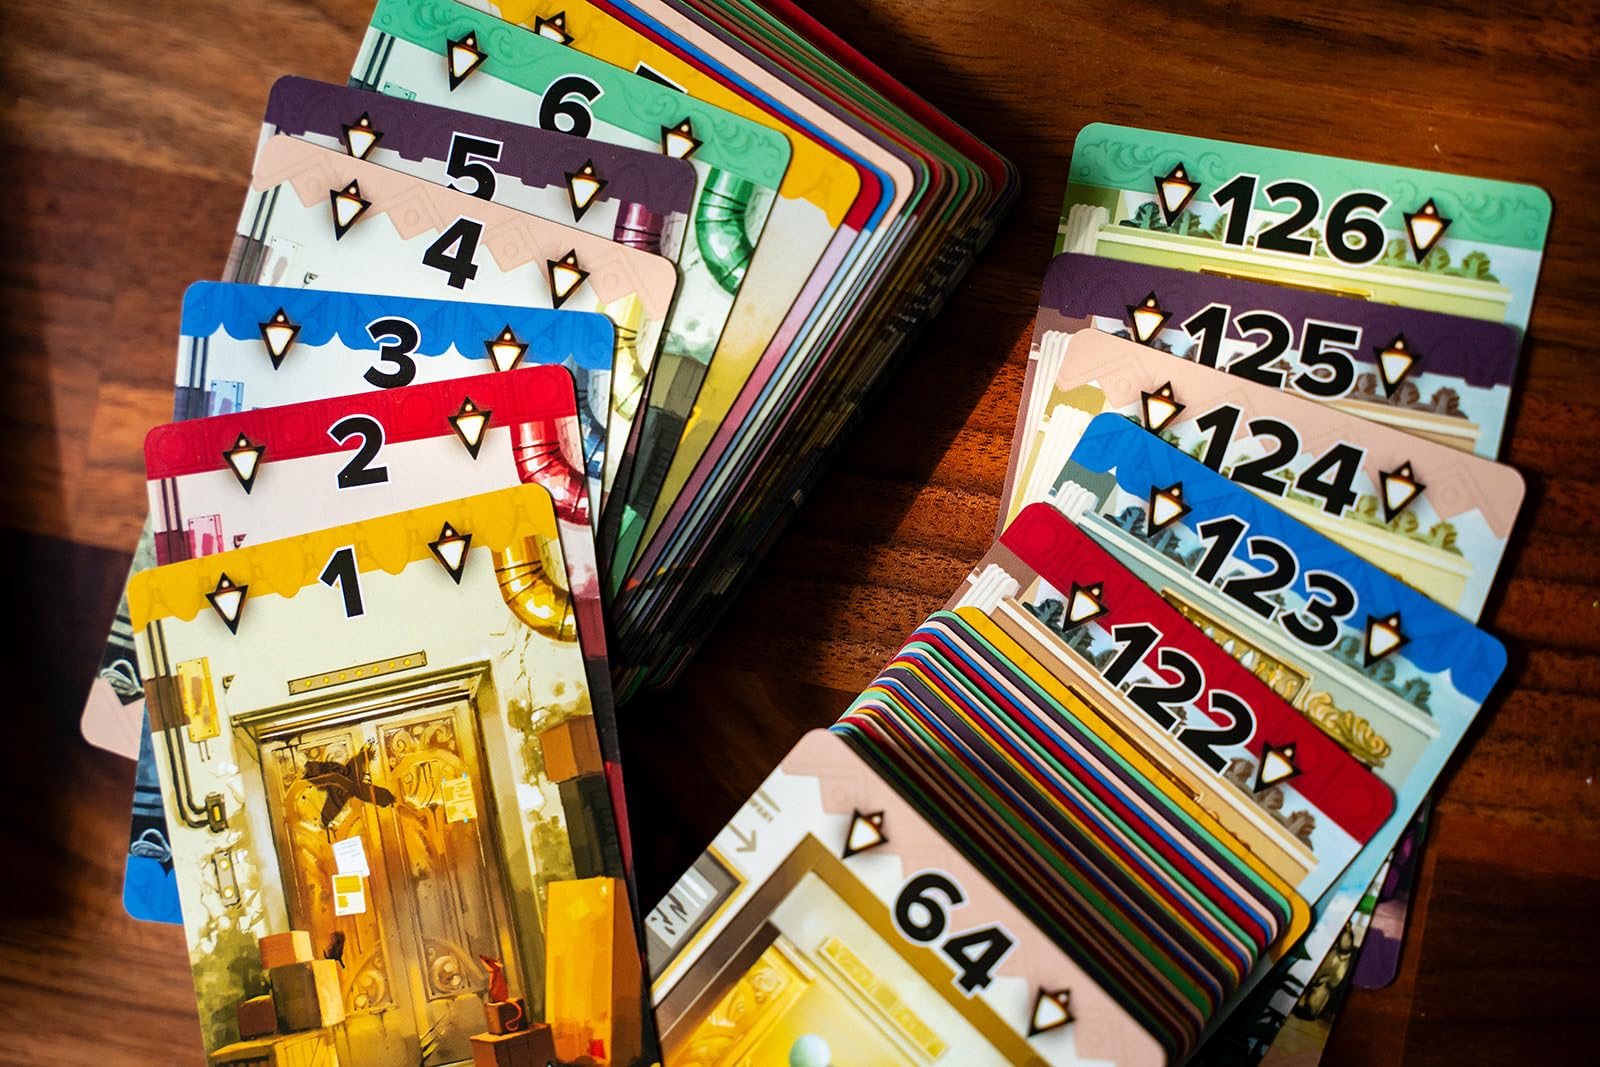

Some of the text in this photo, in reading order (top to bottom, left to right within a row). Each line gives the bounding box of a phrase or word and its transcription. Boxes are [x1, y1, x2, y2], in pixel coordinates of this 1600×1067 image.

[539, 75, 603, 138] 6
[446, 132, 502, 201] 5
[422, 217, 484, 290] 4
[1211, 174, 1391, 265] 126
[363, 316, 420, 388] 3
[1181, 303, 1362, 398] 125
[328, 415, 388, 489] 2
[1196, 405, 1366, 516] 124
[320, 545, 365, 618] 1
[1194, 516, 1358, 649] 123
[1101, 622, 1257, 773] 122
[892, 870, 1016, 996] 64
